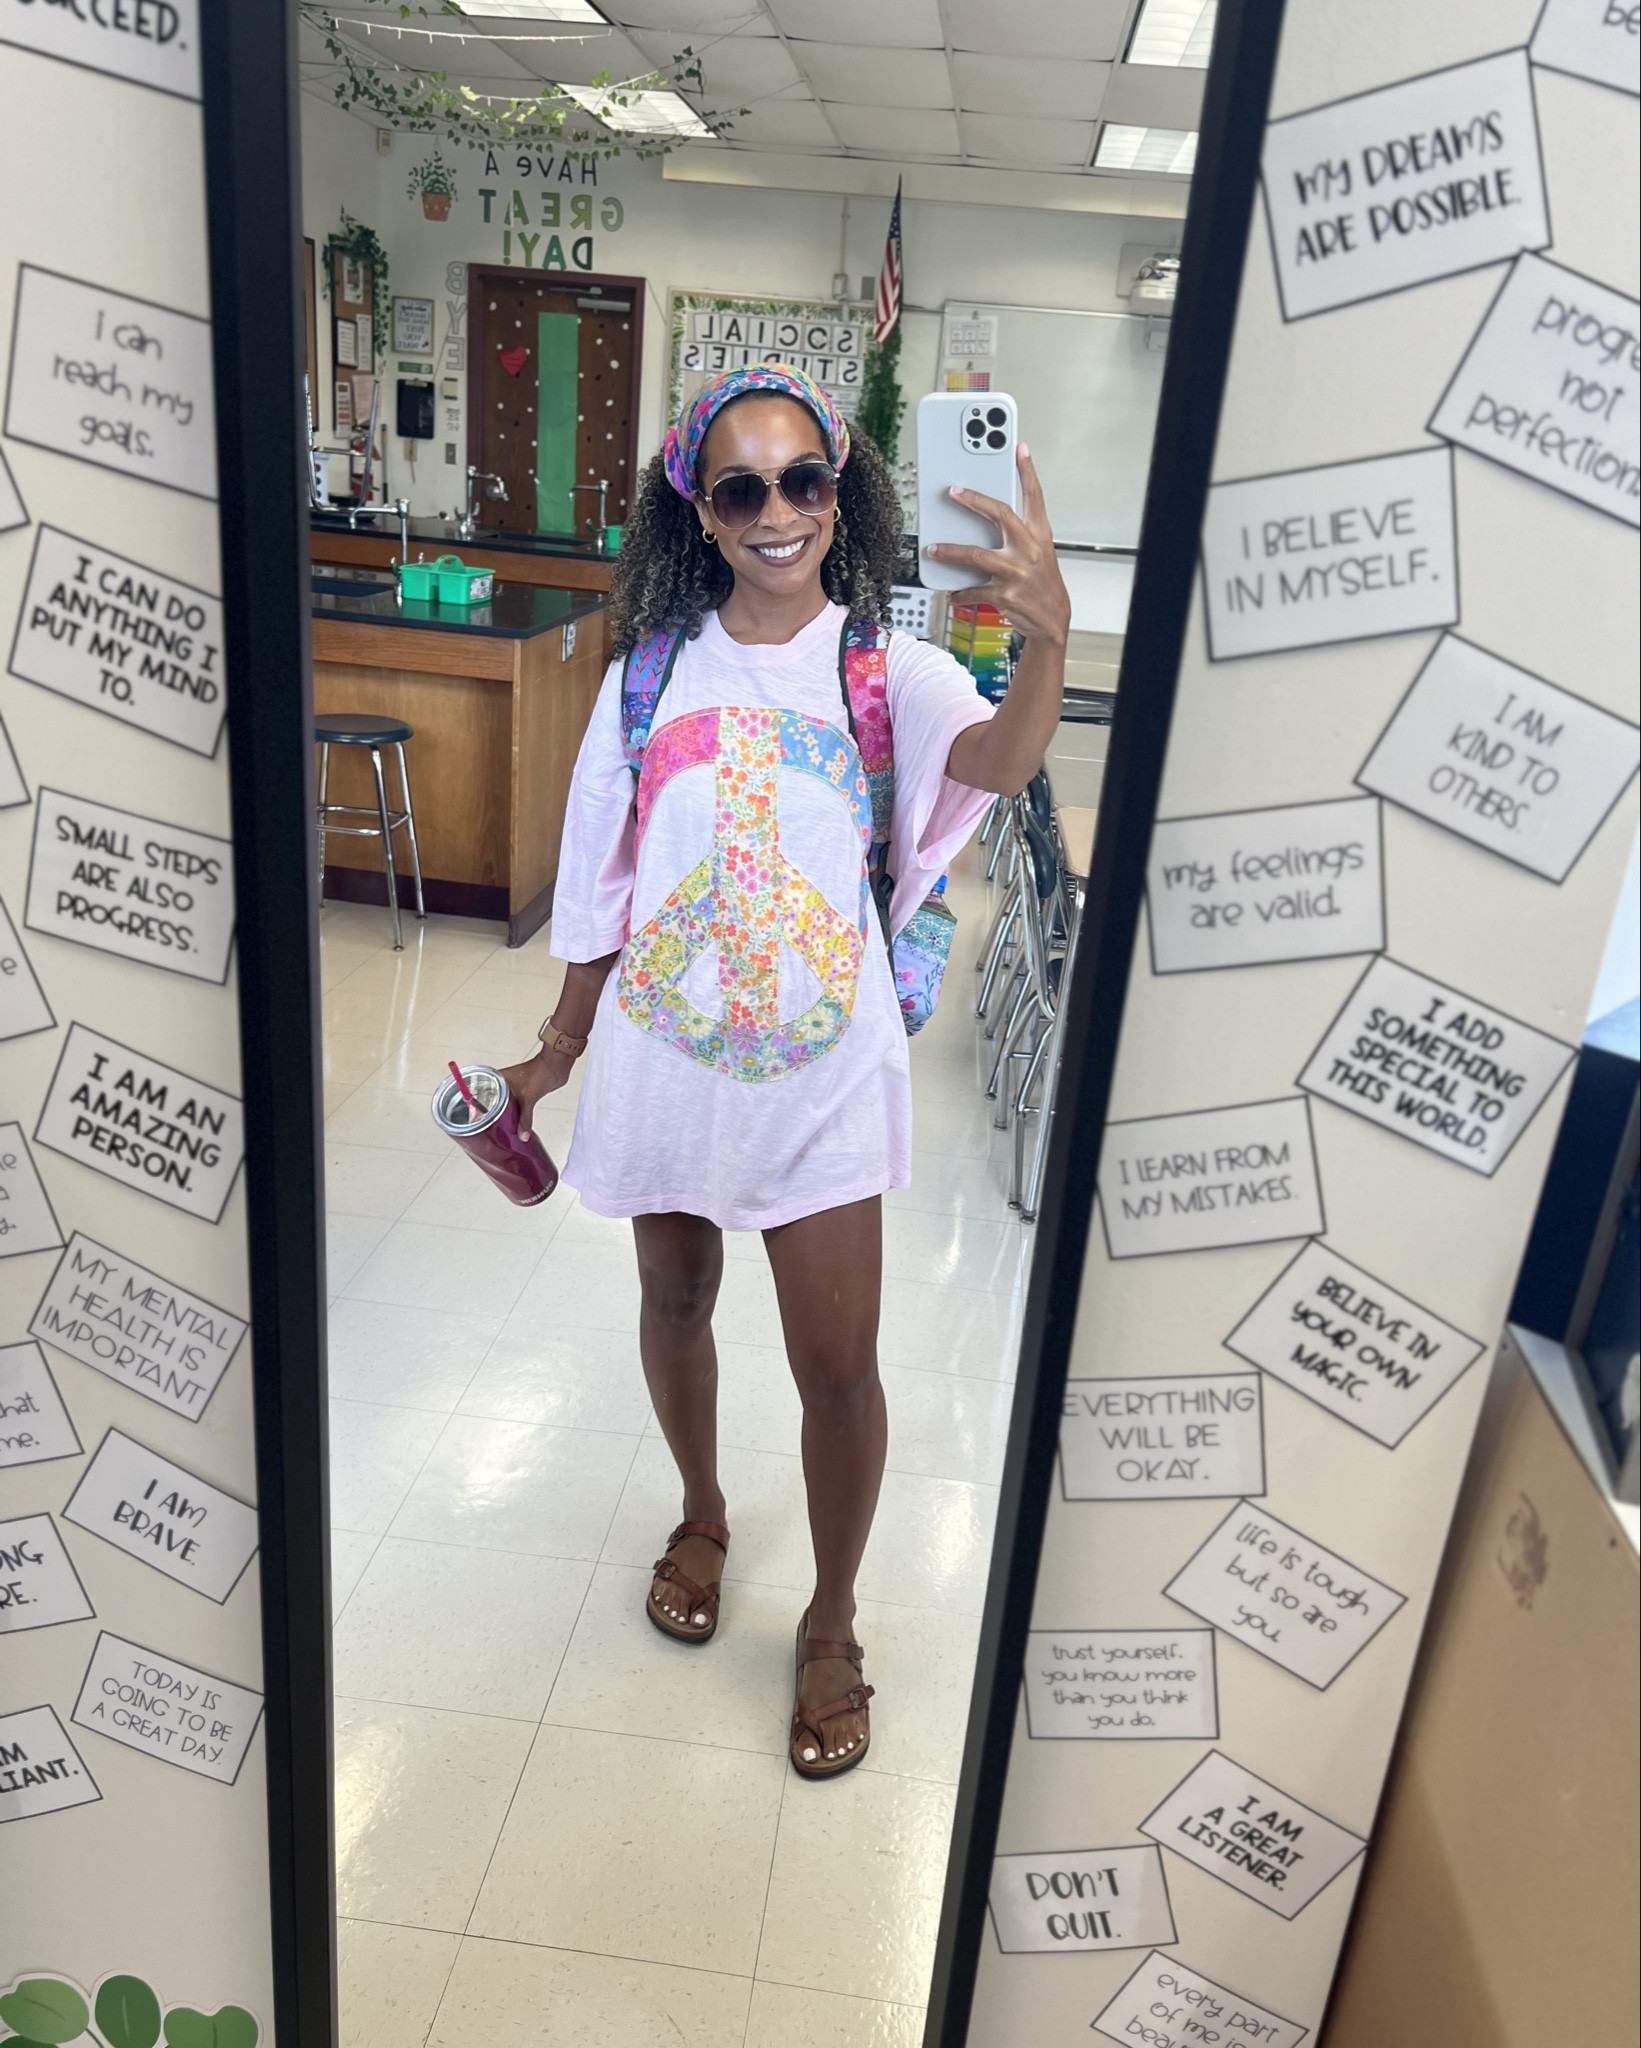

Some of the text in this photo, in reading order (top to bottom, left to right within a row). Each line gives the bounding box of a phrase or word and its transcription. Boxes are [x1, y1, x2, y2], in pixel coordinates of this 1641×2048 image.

[1292, 109, 1504, 206] MY DREAMS
[1295, 167, 1522, 268] ARE POSSIBLE.
[113, 323, 163, 361] can
[53, 353, 194, 426] reach my
[1559, 369, 1626, 423] not
[79, 414, 155, 458] goals.
[1242, 499, 1416, 560] I BELIEVE
[73, 555, 206, 632] I CAN DO
[1226, 547, 1440, 614] IN MYSELF.
[30, 606, 219, 705] PUT MY MIND
[48, 582, 219, 674] ANYTHING I
[98, 668, 135, 706] TO.
[1494, 692, 1565, 747] I AM
[1446, 722, 1561, 796] KIND TO
[55, 815, 223, 886] SMALL STEPS
[1162, 842, 1365, 893] my feelings
[71, 860, 194, 913] ARE ALSO
[1190, 884, 1342, 930] are valid.
[55, 890, 199, 954] PROGRESS.
[1364, 1006, 1527, 1099] SOMETHING
[1421, 997, 1505, 1051] I ADD
[86, 1052, 226, 1137] I AM AN
[1327, 1058, 1488, 1155] THIS WORLD.
[1349, 1035, 1505, 1123] SPECIAL TO
[69, 1083, 222, 1169] AMAZING
[71, 1115, 193, 1193] PERSON.
[1118, 1141, 1290, 1186] I LEARN FROM
[1121, 1190, 1163, 1220] MY
[69, 1284, 206, 1372] HEALTH IS
[70, 1249, 230, 1352] MY MENTAL
[1316, 1275, 1441, 1362] BELIEVE IN
[42, 1305, 207, 1406] IMPORTANT
[1290, 1343, 1370, 1403] MAGIC.
[1356, 1345, 1422, 1391] OWN
[1062, 1387, 1256, 1417] EVERYTHING
[1098, 1423, 1220, 1450] WILL BE
[1116, 1457, 1209, 1482] OKAY.
[113, 1500, 201, 1566] BRAVE.
[142, 1478, 208, 1529] I AM
[1225, 1554, 1338, 1633] but so are
[1235, 1522, 1370, 1616] life is tough
[1041, 1668, 1197, 1685] you know more
[1052, 1643, 1184, 1663] trust yourself.
[101, 1677, 234, 1743] GOING TO BE
[131, 1661, 222, 1712] TODAY IS
[1052, 1689, 1189, 1708] than you think
[91, 1701, 106, 1719] A
[112, 1709, 179, 1749] GREAT
[1087, 1711, 1156, 1730] you do.
[1203, 1806, 1305, 1869] A GREAT
[1236, 1795, 1305, 1843] I AM
[1025, 1867, 1119, 1901] DON'T
[1177, 1815, 1288, 1892] LISTENER.
[1045, 1910, 1122, 1941] QUIT.
[1149, 2001, 1184, 2024] of
[1182, 2017, 1220, 2045] me
[1156, 1973, 1280, 2044] every part
